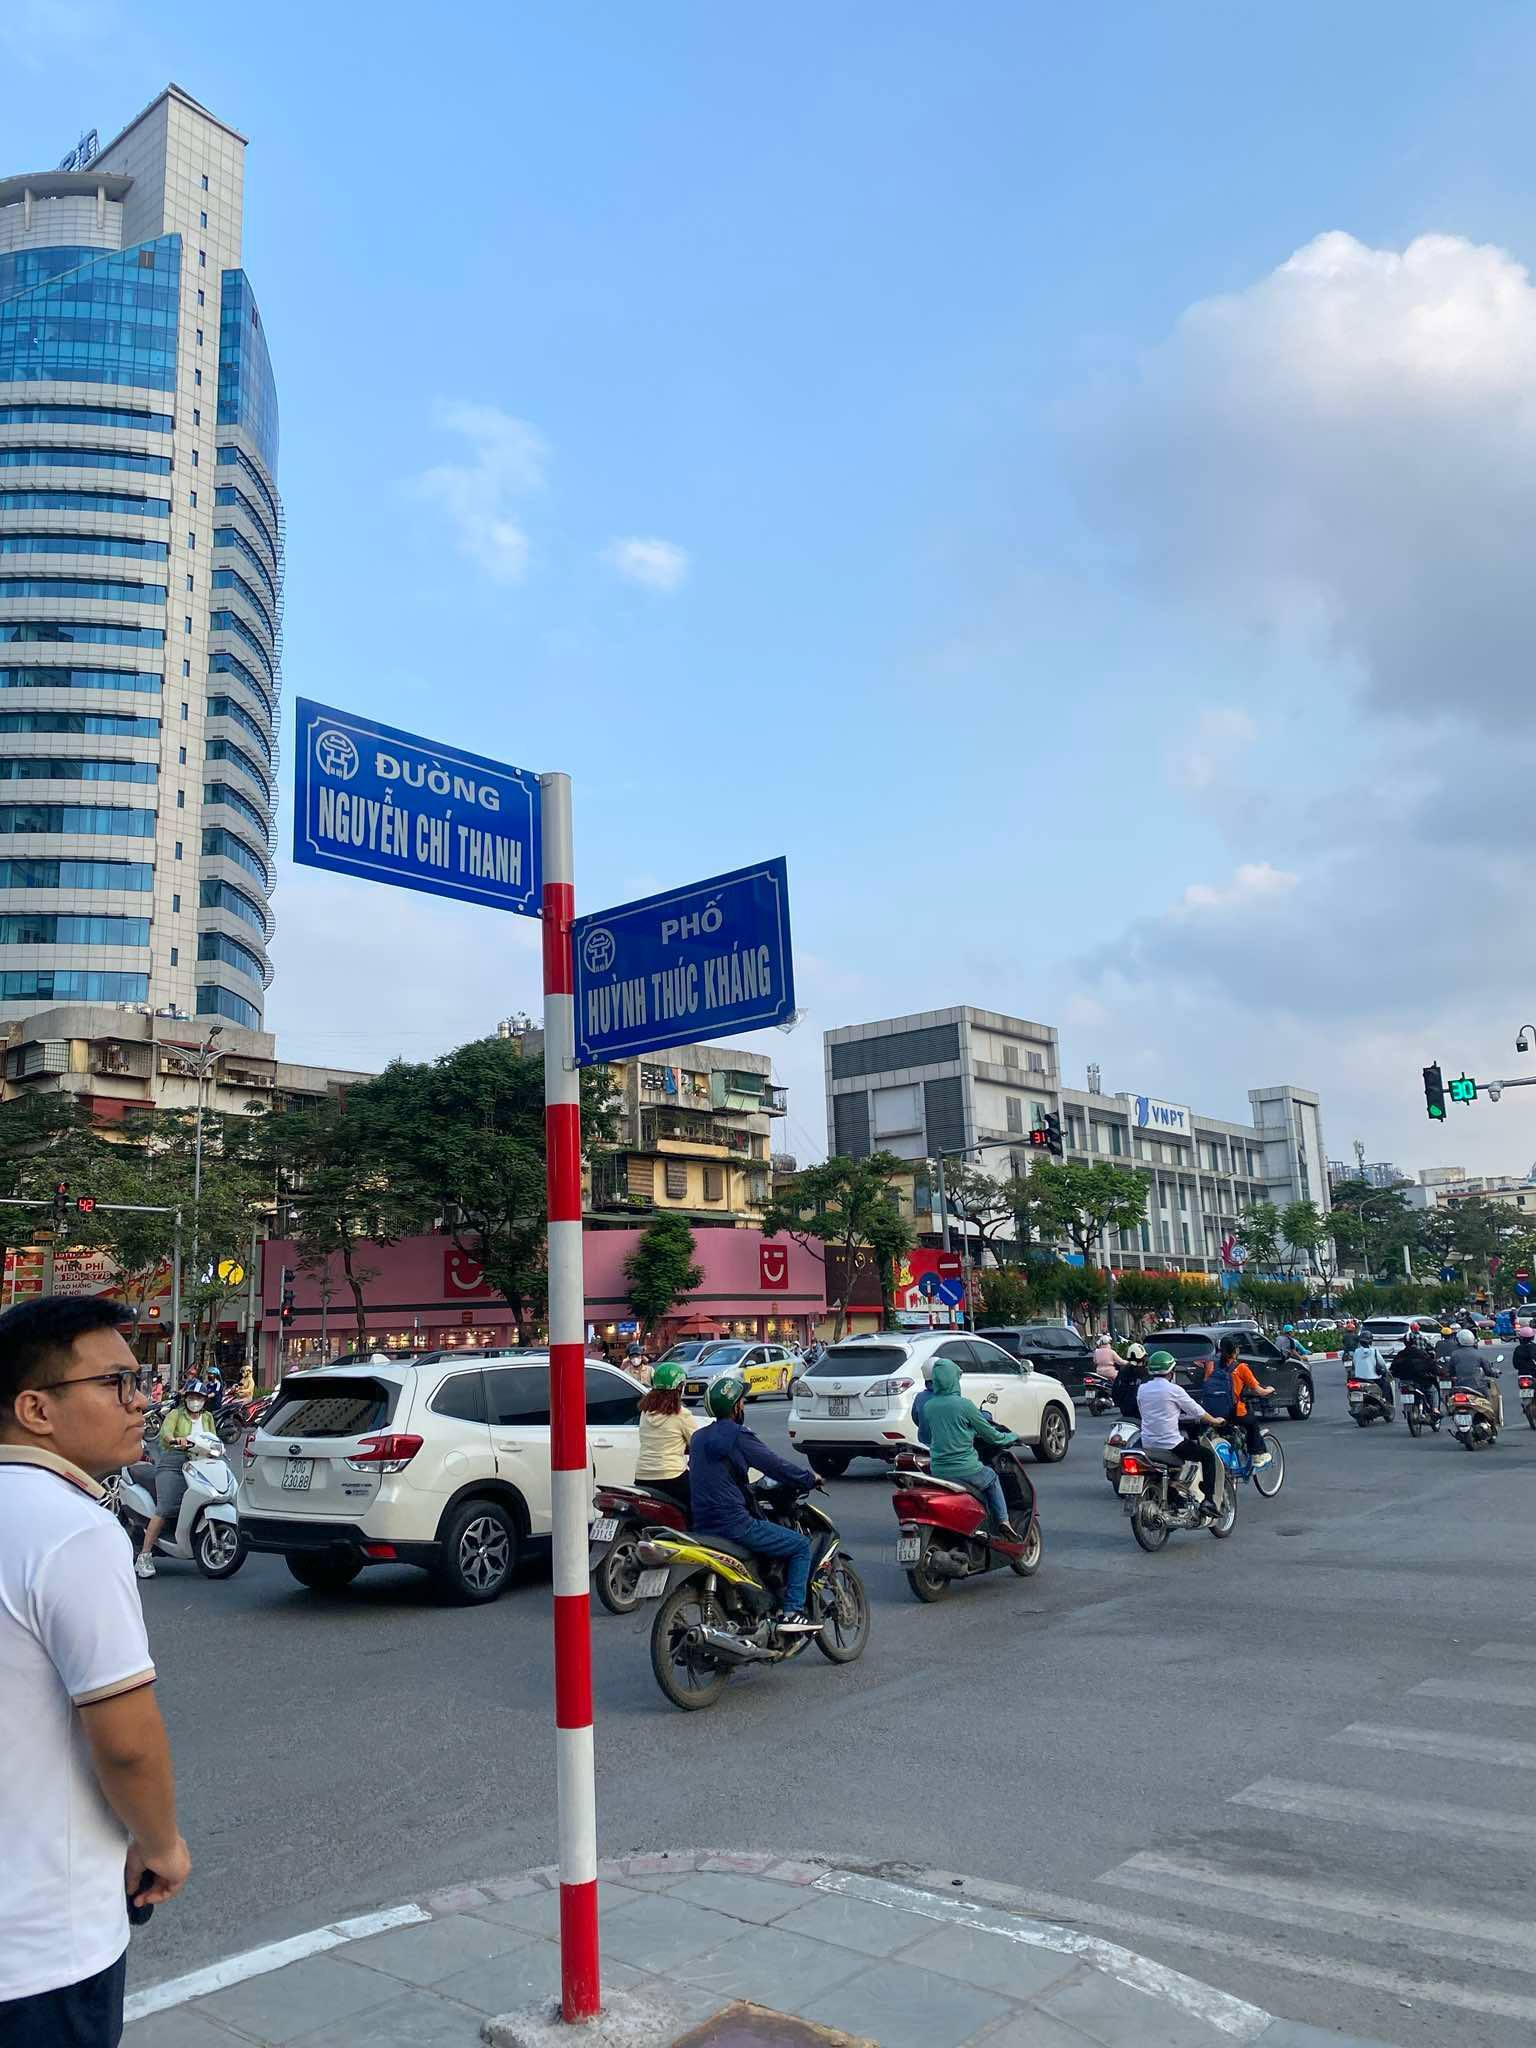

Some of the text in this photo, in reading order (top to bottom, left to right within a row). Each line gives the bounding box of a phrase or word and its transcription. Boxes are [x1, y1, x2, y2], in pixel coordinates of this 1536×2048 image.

[375, 752, 500, 811] ĐƯỜNG
[319, 786, 521, 886] NGUYỄN CHÍ THANH
[661, 894, 723, 944] PHỐ
[587, 941, 770, 1036] HUỲNH THÚC KHÁNG
[1451, 1080, 1474, 1100] 30
[1152, 1105, 1184, 1128] VNPT
[1034, 1132, 1046, 1144] 31
[79, 1199, 94, 1212] 42
